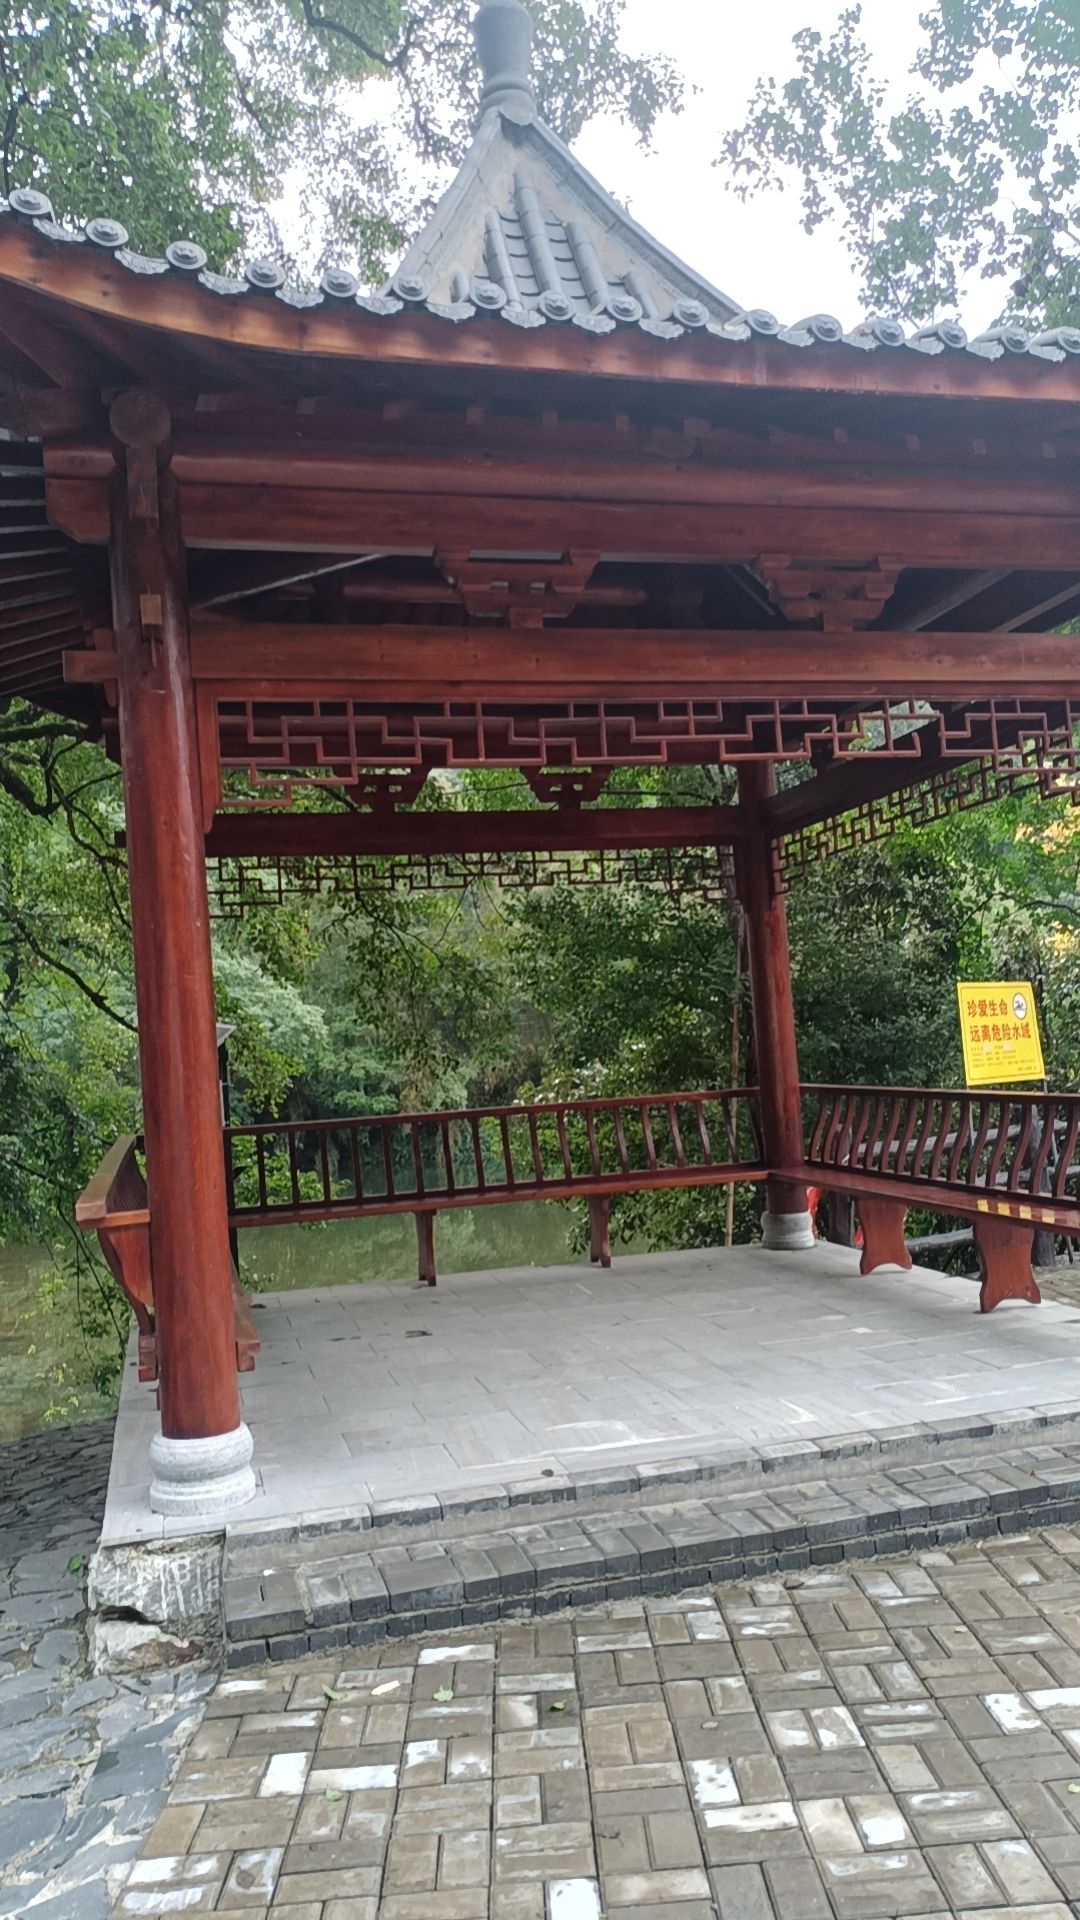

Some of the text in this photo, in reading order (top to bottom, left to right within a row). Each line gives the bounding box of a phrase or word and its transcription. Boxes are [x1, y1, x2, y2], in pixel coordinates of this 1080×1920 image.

[967, 999, 1008, 1017] 珍爱生命
[969, 1022, 1031, 1042] 远离危险水域
